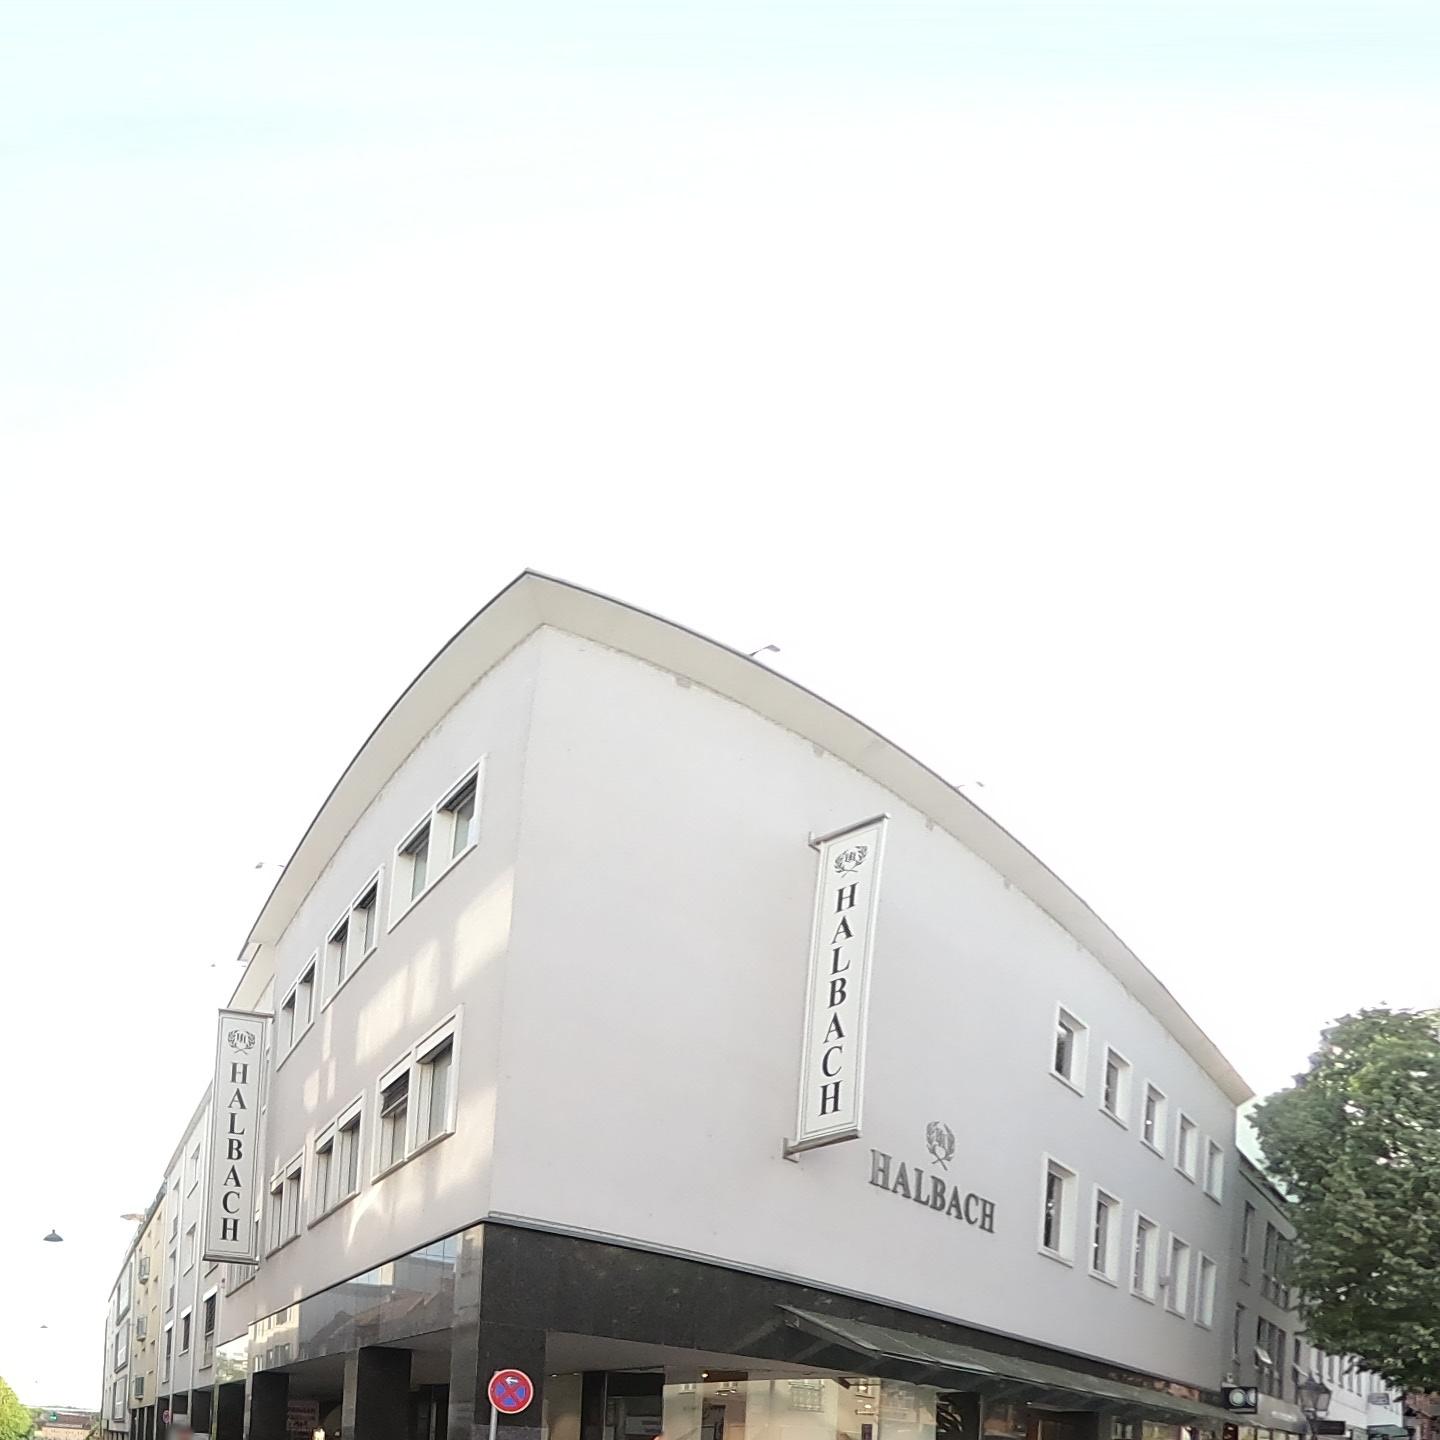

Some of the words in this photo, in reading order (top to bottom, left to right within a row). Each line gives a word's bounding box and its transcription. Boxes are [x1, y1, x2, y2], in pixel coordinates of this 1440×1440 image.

[819, 881, 858, 1117] HALBACH
[220, 1062, 249, 1242] HALBACH
[868, 1148, 997, 1234] HALBACH
